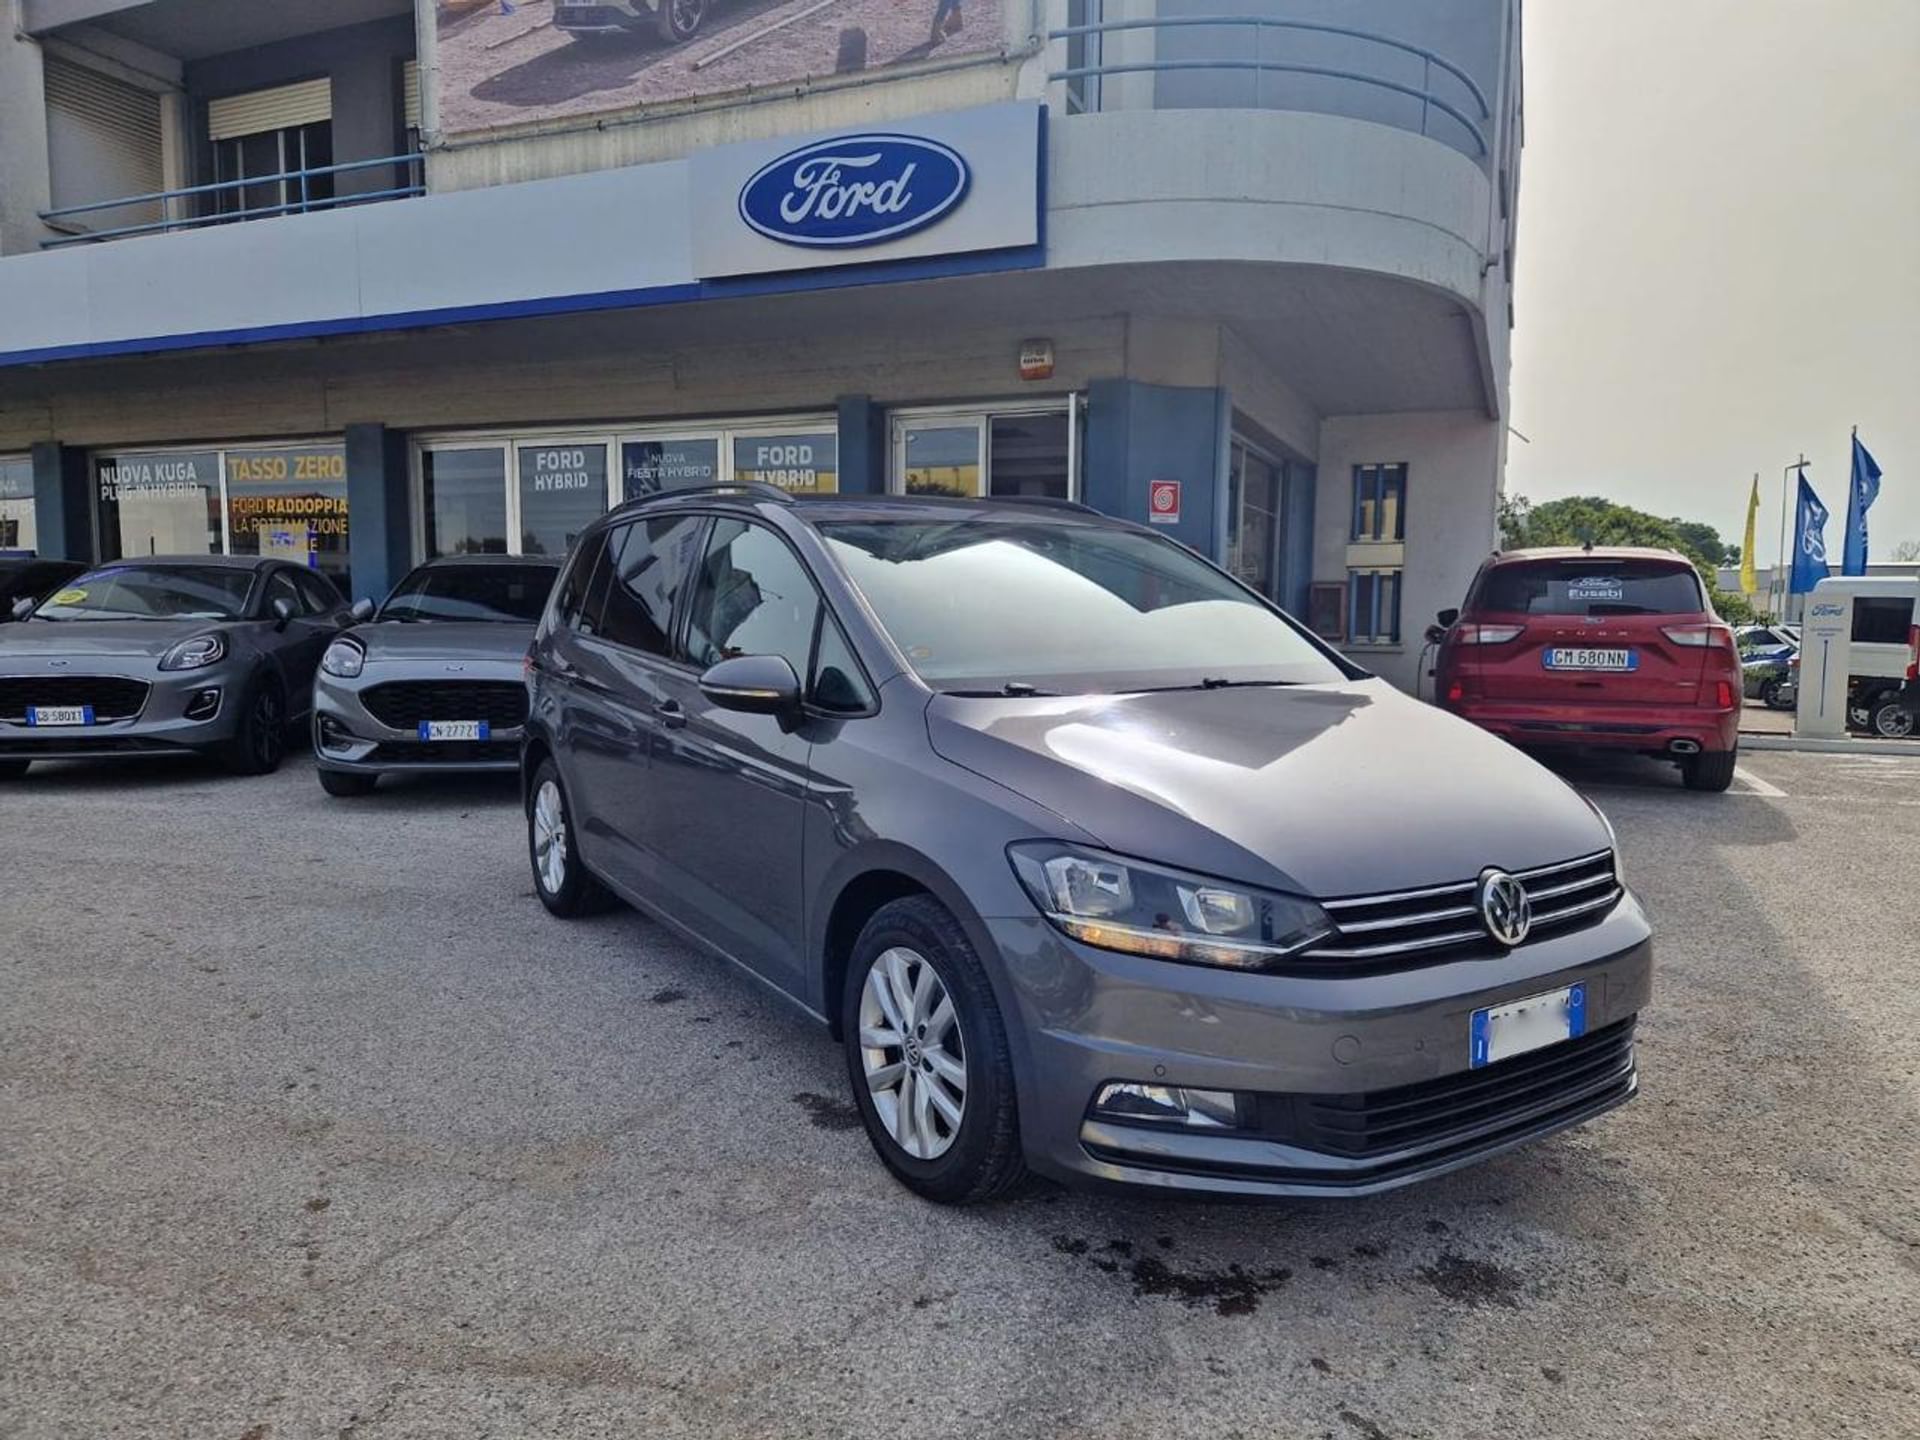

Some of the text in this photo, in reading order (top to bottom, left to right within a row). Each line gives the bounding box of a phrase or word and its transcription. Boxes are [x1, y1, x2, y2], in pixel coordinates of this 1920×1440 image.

[780, 153, 917, 224] Ford
[536, 451, 585, 471] FORD
[651, 453, 686, 463] NUOVA
[757, 445, 813, 467] FORD
[101, 462, 197, 485] NUOVA KUGA
[229, 455, 345, 480] TASSO ZERO
[627, 465, 711, 479] FIESTA HYBRID
[535, 472, 588, 490] HYBRID
[754, 469, 815, 487] HYBRID
[151, 481, 198, 498] HYBRID
[232, 496, 348, 514] FORD RADDOPPIA
[233, 517, 249, 533] LA
[1811, 603, 1844, 617] Ford
